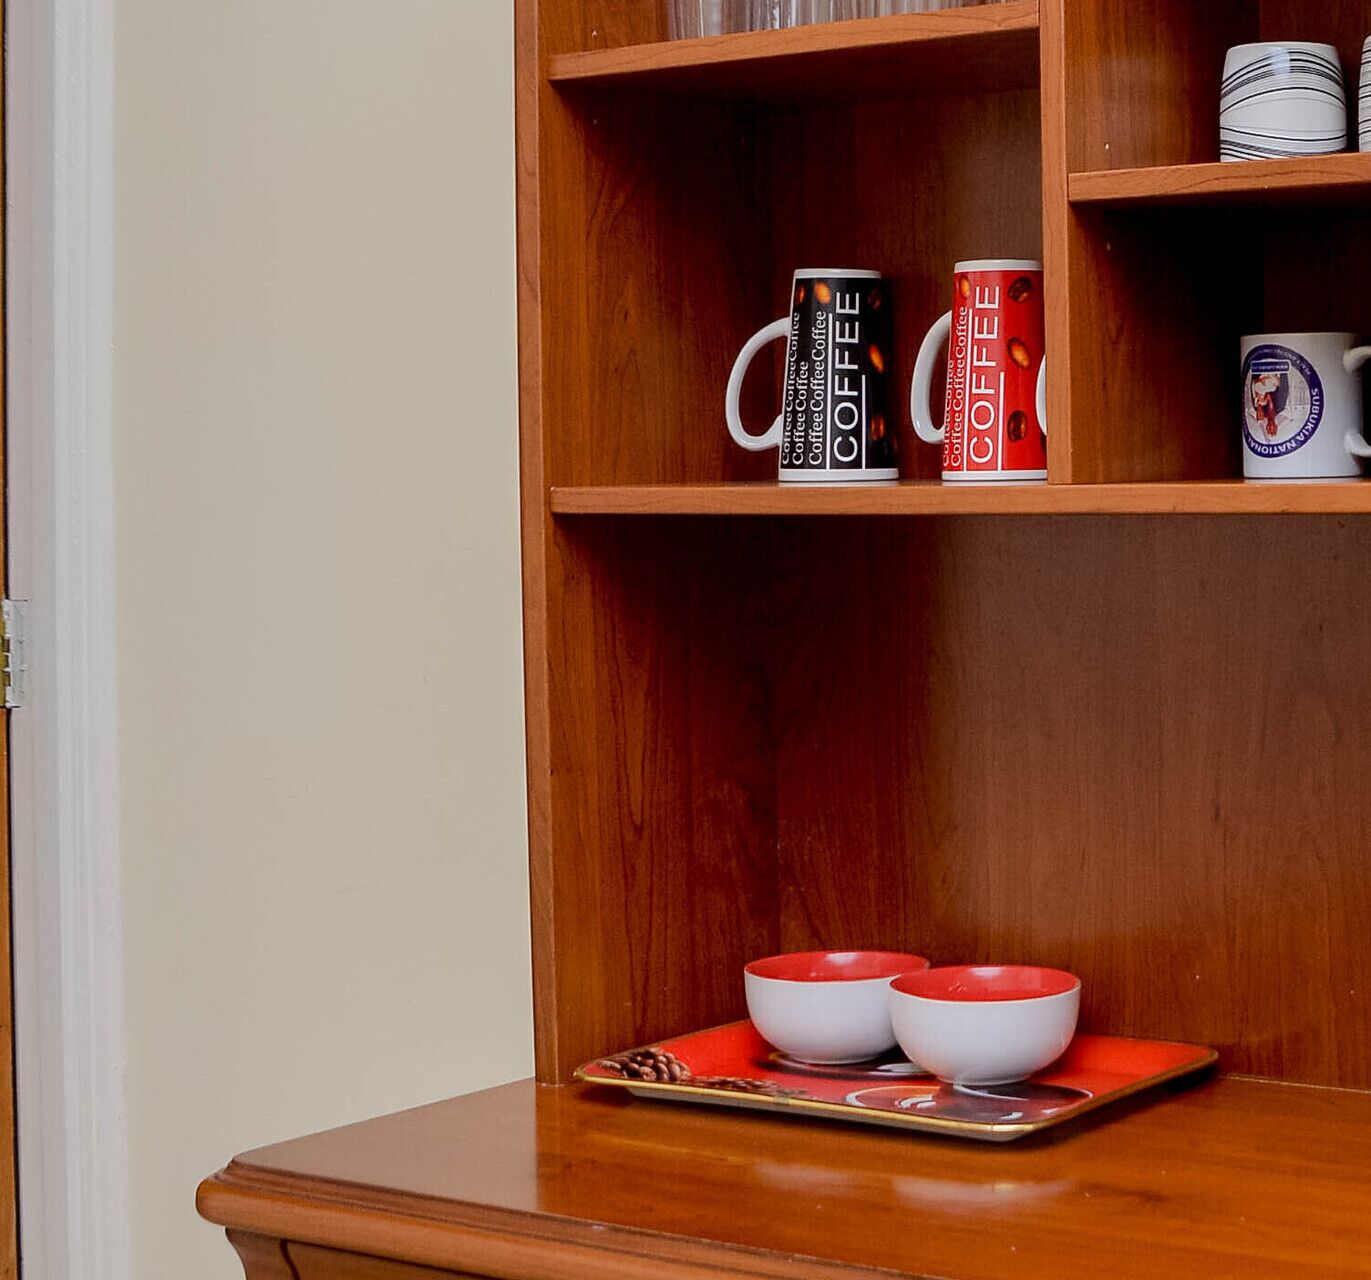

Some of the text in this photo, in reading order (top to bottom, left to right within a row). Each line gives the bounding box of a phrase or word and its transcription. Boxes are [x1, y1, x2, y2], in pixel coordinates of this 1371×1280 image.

[792, 361, 809, 465] Coffee Coffee
[808, 311, 827, 465] Coffee Coffee Coffee
[833, 292, 860, 462] COFFEE
[950, 306, 968, 467] Coffee Coffee Coffee
[969, 285, 1000, 463] COFFEE
[1296, 388, 1321, 443] SUBUKIA
